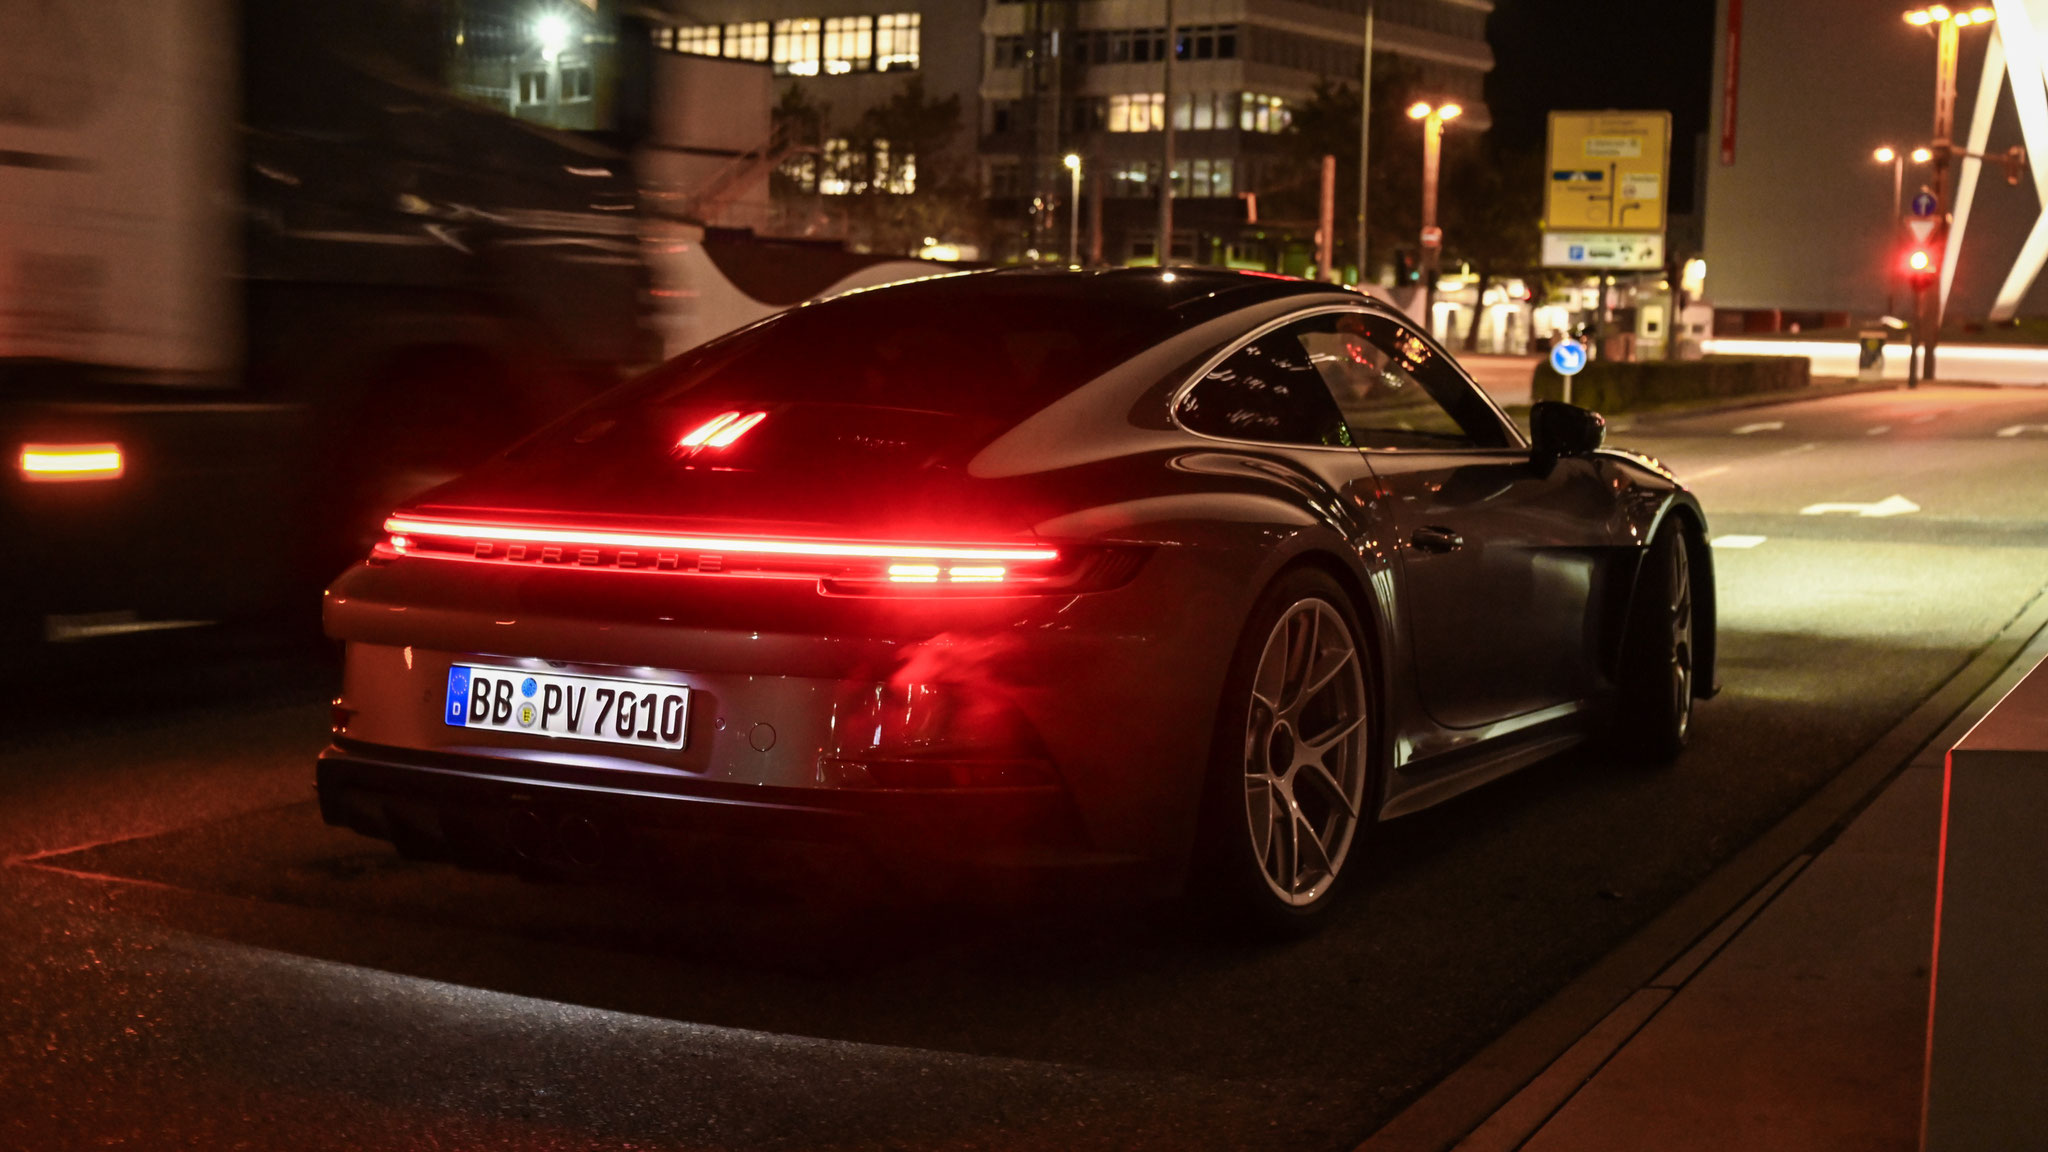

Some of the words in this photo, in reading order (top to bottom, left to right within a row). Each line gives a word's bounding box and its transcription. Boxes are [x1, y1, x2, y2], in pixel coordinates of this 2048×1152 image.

[473, 542, 723, 572] PORSCHE
[452, 702, 461, 716] D
[469, 677, 514, 725] BB
[541, 684, 587, 733] PV
[594, 688, 684, 743] 7010
